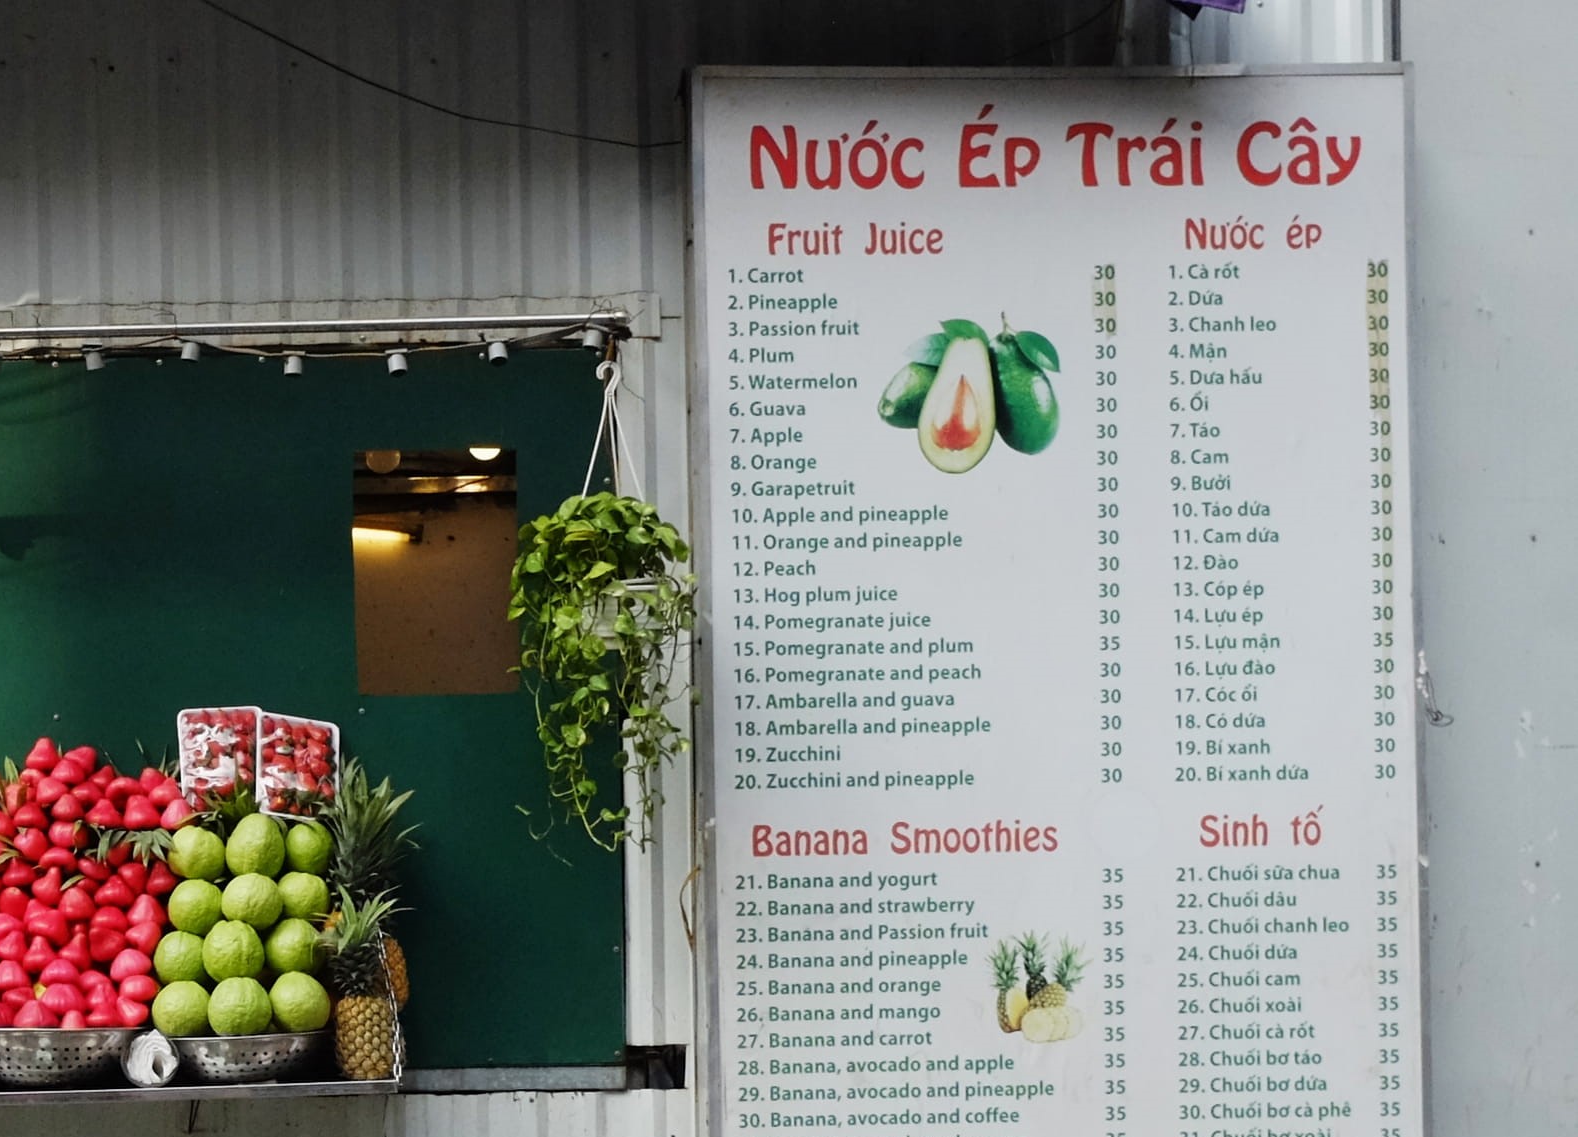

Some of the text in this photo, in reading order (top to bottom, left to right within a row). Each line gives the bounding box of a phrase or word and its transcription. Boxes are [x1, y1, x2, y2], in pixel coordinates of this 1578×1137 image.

[750, 104, 1361, 190] Nước Ép Trái Cây
[768, 221, 944, 256] Fruit Juice
[1184, 215, 1322, 250] Nước ép
[728, 268, 803, 283] 1. Carrot
[1094, 264, 1115, 280] 30
[1169, 262, 1239, 279] 1. Cà rốt
[1367, 260, 1388, 278] 30
[729, 320, 859, 336] 3. Passion fruit
[1095, 317, 1116, 336] 30
[1169, 316, 1276, 332] 3. Chanh leo
[1368, 315, 1389, 330] 30
[1170, 449, 1229, 464] 8. Cam
[1370, 446, 1392, 462] 30
[732, 504, 948, 527] 10. Apple and pineapple
[1098, 504, 1119, 518] 30
[734, 560, 816, 576] 12. Peach
[1098, 556, 1119, 571] 30
[1175, 633, 1280, 653] 15. Lựu mận
[1374, 632, 1393, 647] 35
[735, 716, 991, 737] 18. Ambarella and pineapple
[1101, 715, 1122, 730] 30
[1176, 739, 1270, 755] 19. Bí xanh
[1375, 738, 1395, 752] 30
[1199, 805, 1324, 847] Sinh tố
[752, 819, 1058, 857] Banana Smoothies
[736, 897, 975, 916] 22. Banana and strawberry
[1103, 895, 1123, 909] 35
[1178, 970, 1300, 987] 25. Chuối cam
[1378, 970, 1398, 984] 35
[738, 1030, 932, 1049] 27. Banana and carrot
[1104, 1027, 1125, 1042] 35
[1179, 1075, 1327, 1093] 29. Chuối bơ dứa
[1380, 1075, 1400, 1090] 35
[739, 1107, 1020, 1128] 30. Banana, avocado and coffee
[1106, 1106, 1126, 1121] 35
